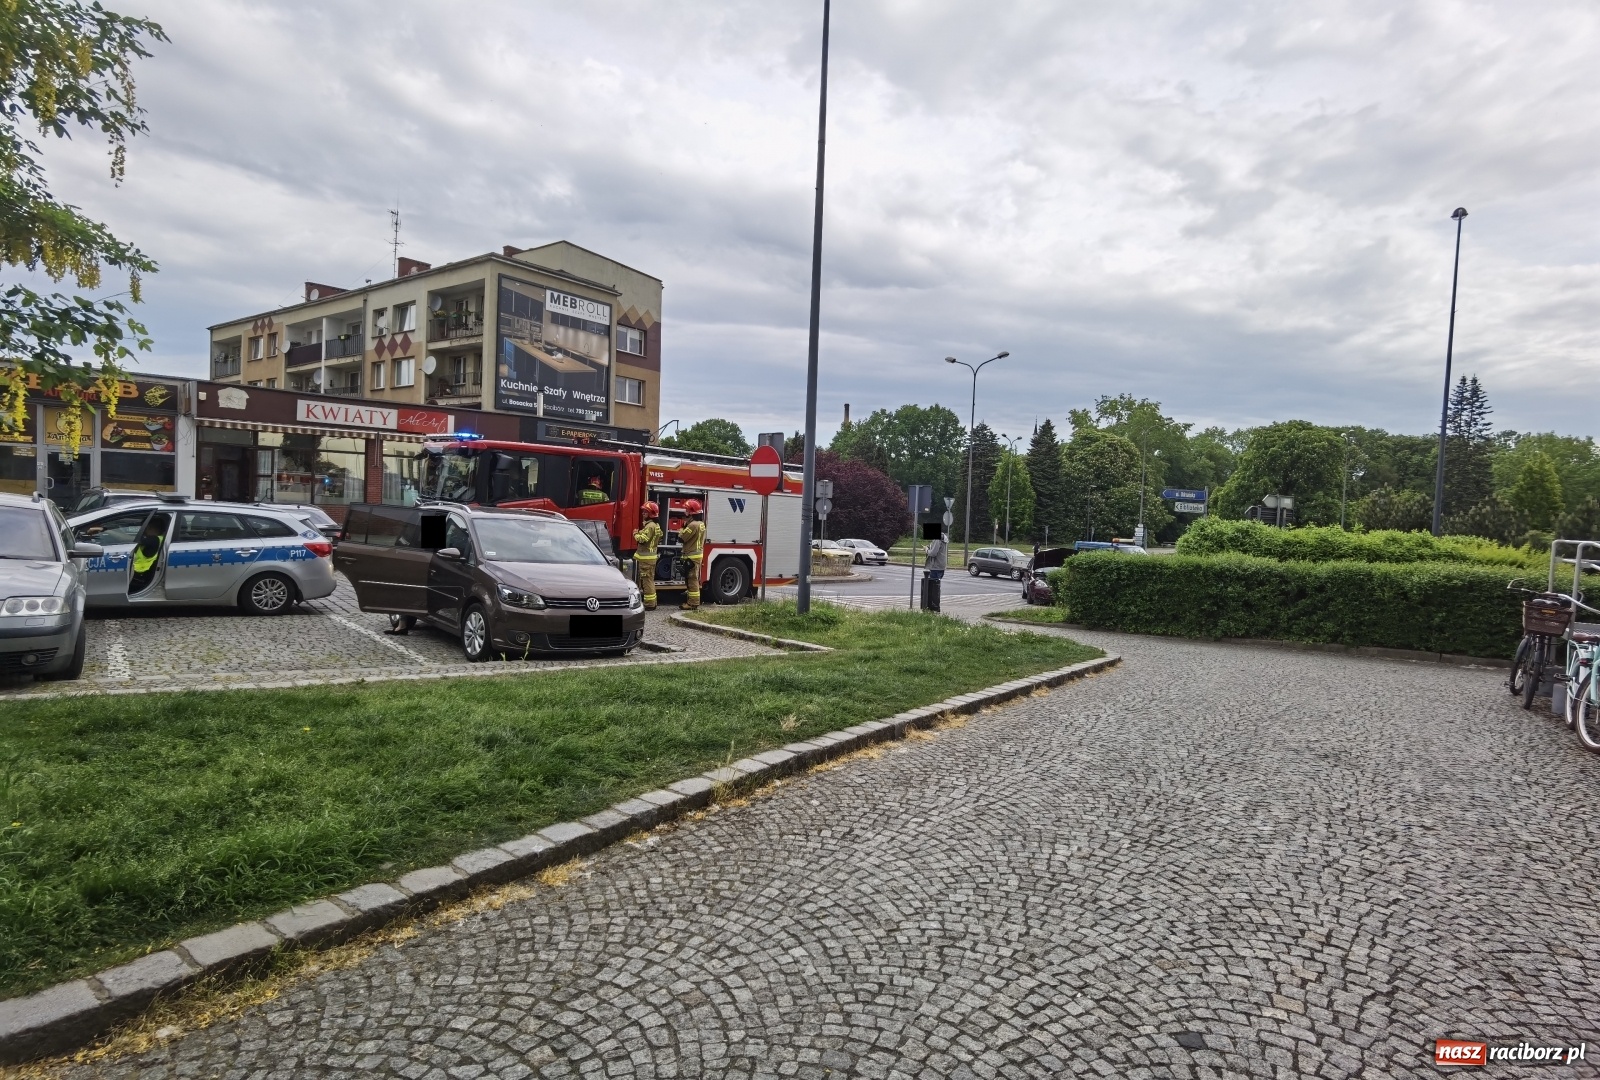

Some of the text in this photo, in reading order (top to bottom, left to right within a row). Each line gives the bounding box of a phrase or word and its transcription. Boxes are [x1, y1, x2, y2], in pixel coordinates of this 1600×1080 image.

[550, 291, 607, 318] MEBROLL
[500, 379, 606, 403] Kuchnie Szafy Wnętrza
[305, 403, 393, 426] KWIATY
[509, 398, 533, 408] Bosacka
[290, 549, 306, 557] P117
